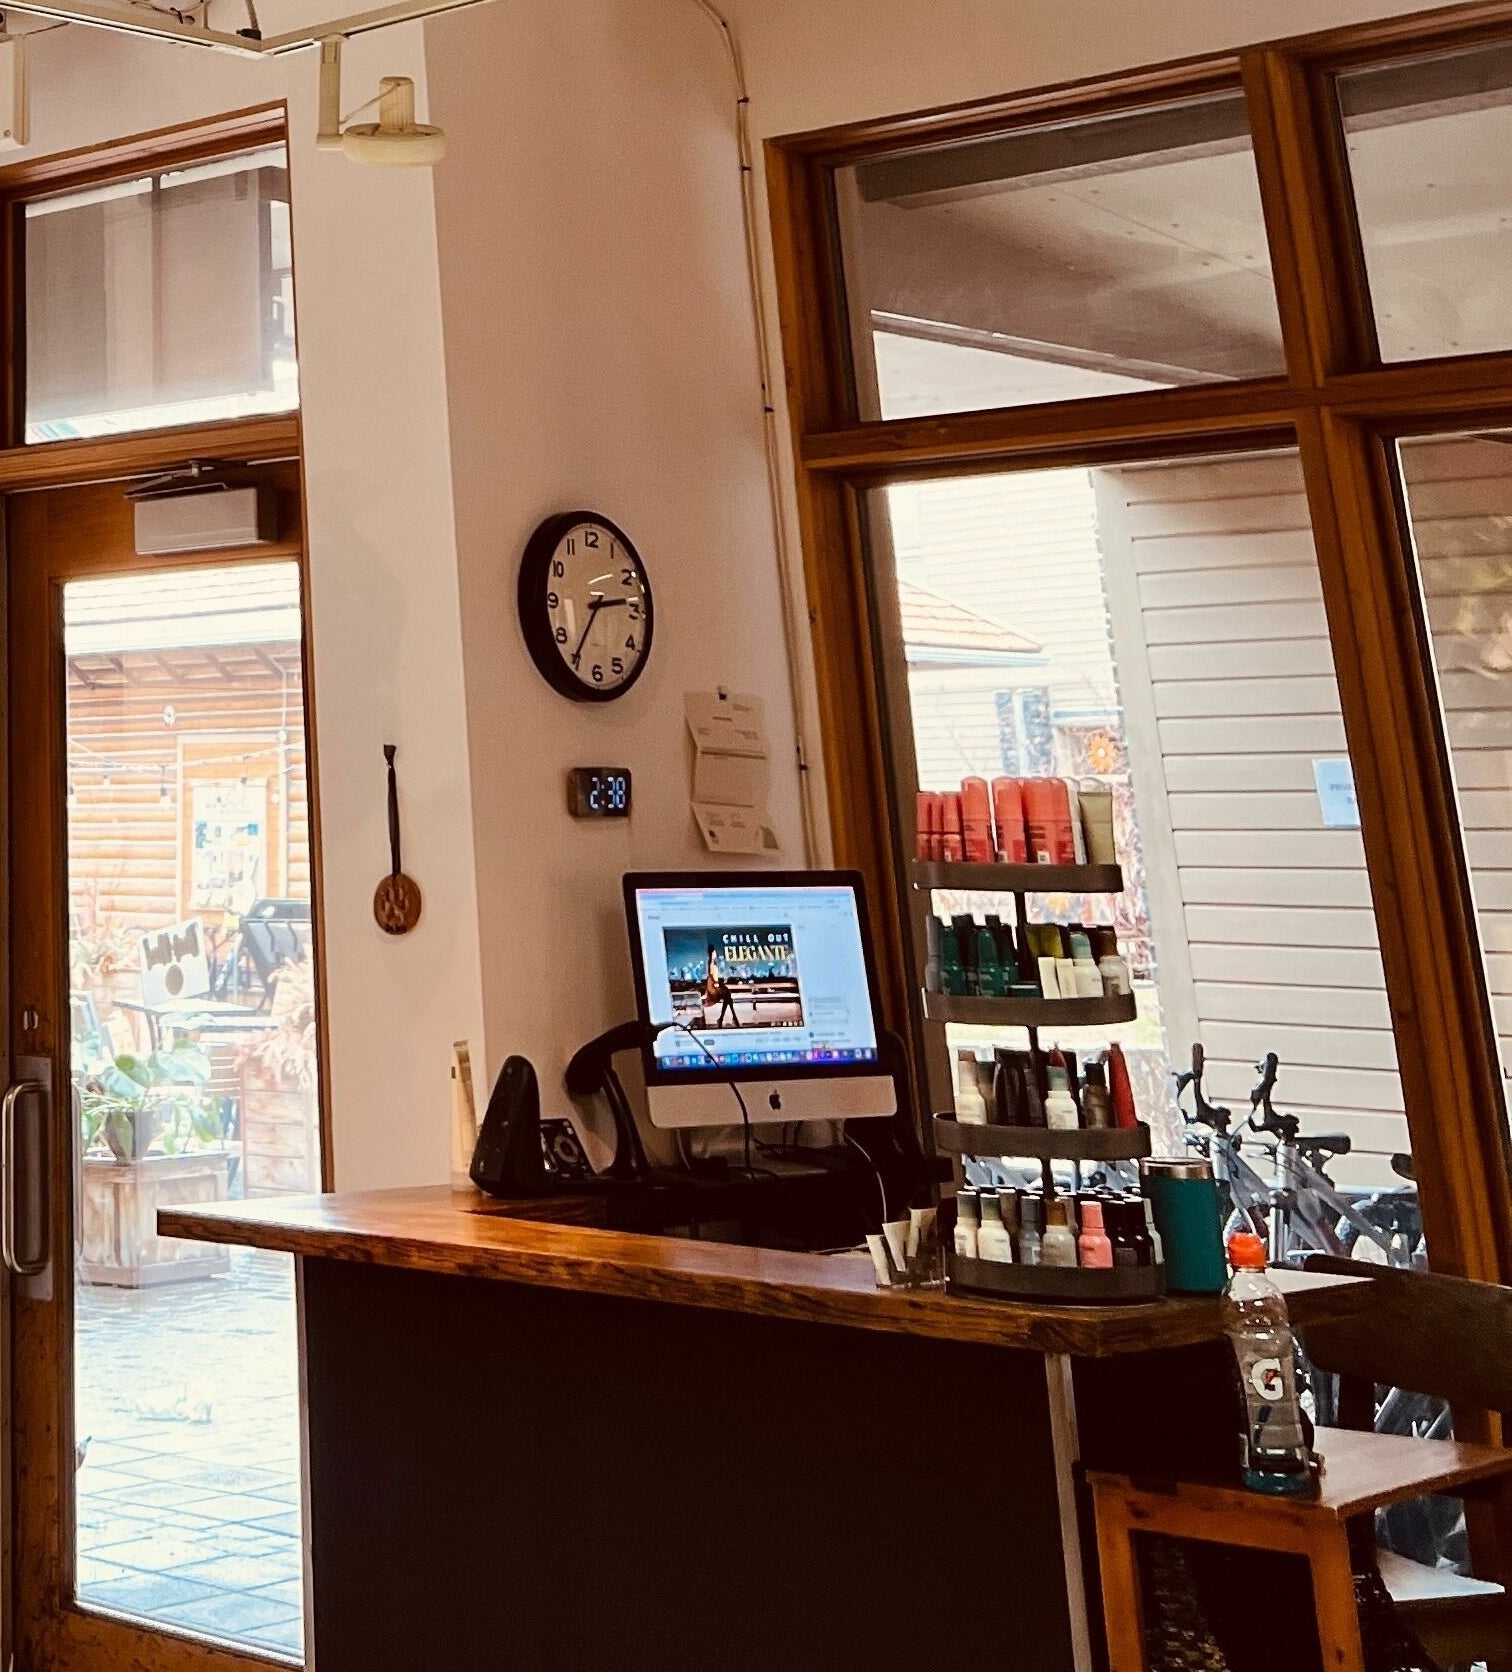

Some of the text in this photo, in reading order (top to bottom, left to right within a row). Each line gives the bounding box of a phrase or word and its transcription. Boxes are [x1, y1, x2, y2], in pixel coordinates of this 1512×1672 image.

[567, 538, 575, 556] 11
[584, 531, 599, 548] 12
[609, 541, 615, 559] 1
[552, 560, 564, 578] 10
[621, 569, 633, 586] 2
[548, 592, 559, 608] 9
[629, 603, 641, 620] 3
[556, 627, 567, 644] 8
[625, 634, 635, 650] 4
[592, 664, 604, 682] 6
[612, 657, 623, 675] 5
[590, 776, 626, 809] 2:38
[722, 933, 789, 944] CHILL OUT
[724, 945, 789, 962] ELEGANTE
[1251, 1357, 1284, 1401] G
